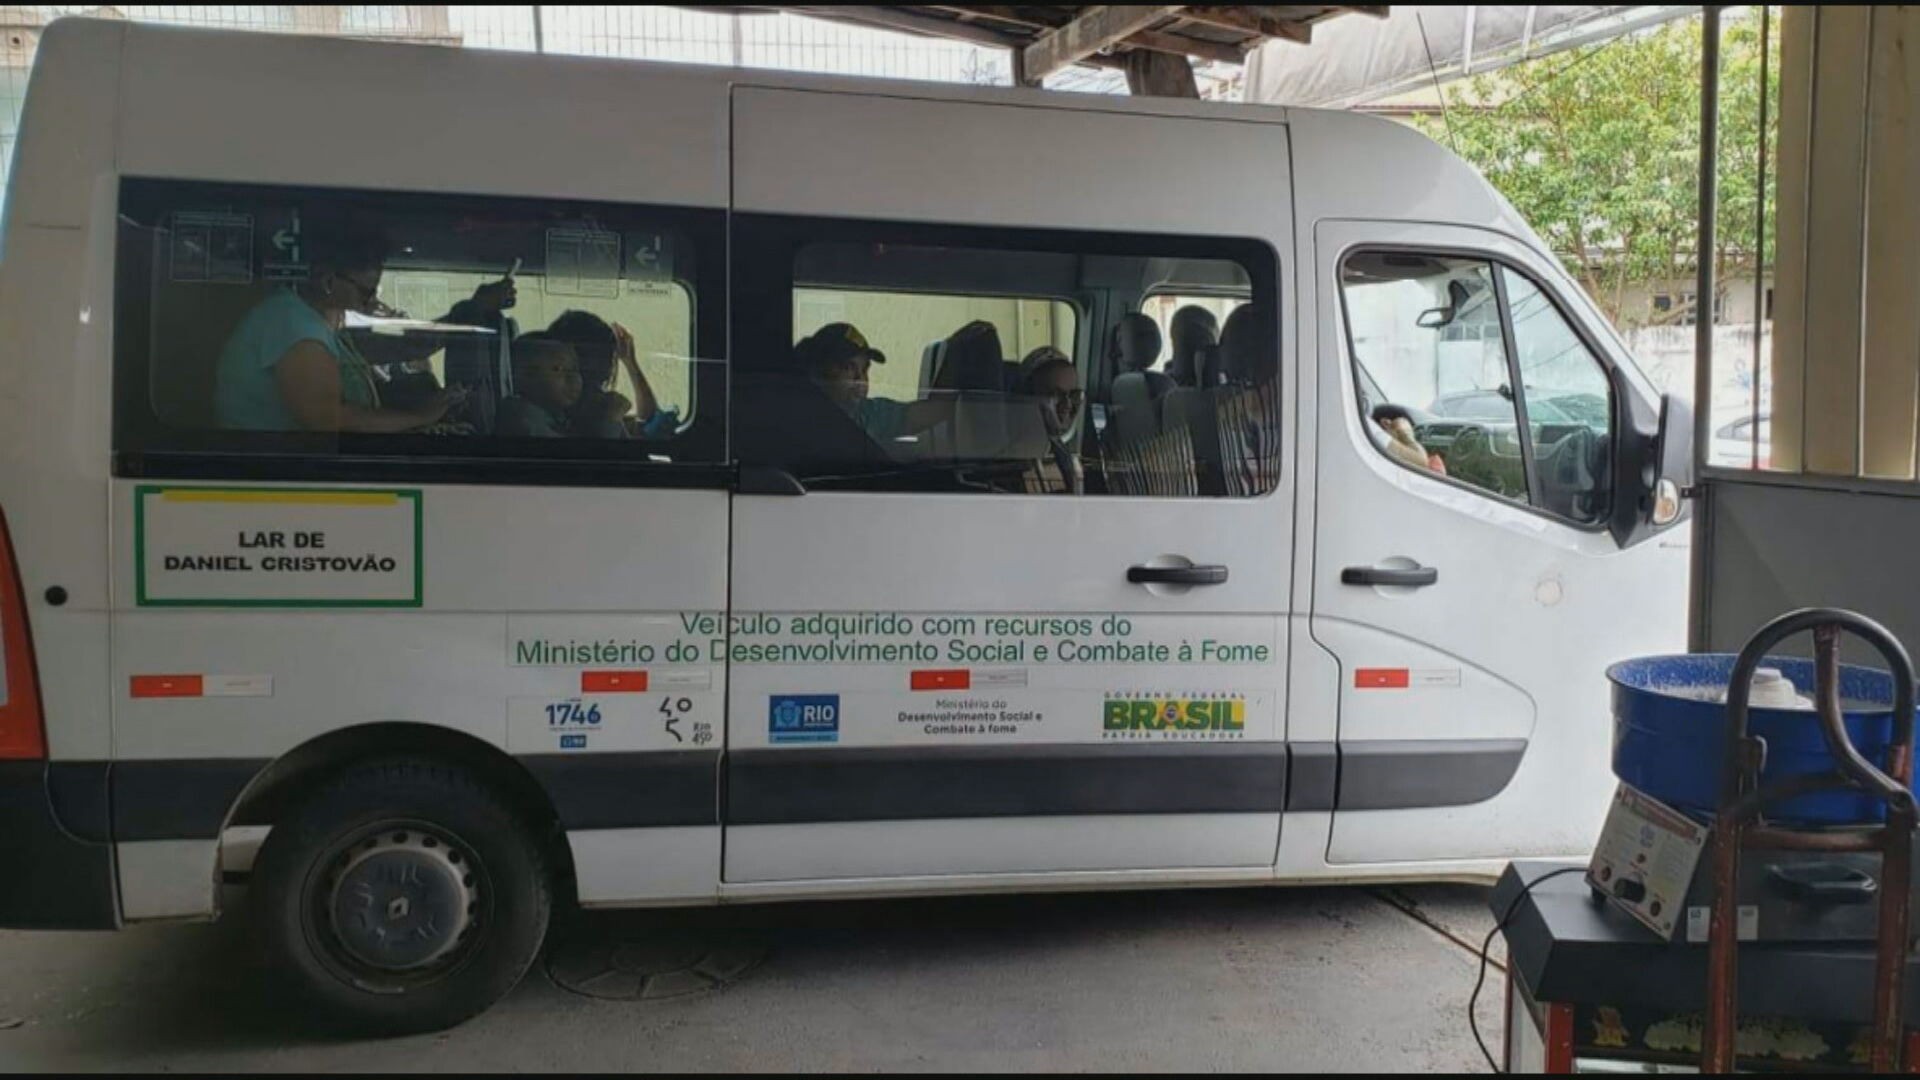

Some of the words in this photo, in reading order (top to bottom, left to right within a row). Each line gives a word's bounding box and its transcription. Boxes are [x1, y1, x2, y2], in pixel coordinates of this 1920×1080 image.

[238, 532, 286, 548] LAR
[293, 532, 325, 548] DE
[164, 556, 252, 570] DANIEL
[261, 553, 396, 571] CRISTOVÃO
[680, 612, 781, 635] Veículo
[791, 614, 913, 640] adquirido
[921, 619, 976, 635] com
[984, 619, 1093, 636] recursos
[1101, 615, 1132, 636] do
[516, 639, 655, 663] Ministério
[665, 642, 700, 662] do
[709, 639, 939, 662] Desenvolvimento
[947, 640, 1024, 662] Social
[1033, 646, 1048, 662] e
[1056, 640, 1169, 662] Combate
[1177, 641, 1193, 662] à
[1201, 640, 1269, 662] Fome
[1104, 691, 1172, 699] GOVERNO
[1181, 691, 1246, 699] FEDERAL
[936, 699, 988, 709] Ministério
[993, 699, 1007, 709] do
[545, 704, 602, 725] 1746
[803, 705, 834, 721] RIO
[898, 711, 996, 722] Desenvolvimento
[1000, 711, 1033, 722] Social
[1103, 700, 1245, 730] BRASIL
[924, 724, 975, 734] Combate
[989, 723, 1017, 733] fome
[1163, 731, 1245, 739] EDUCADORA
